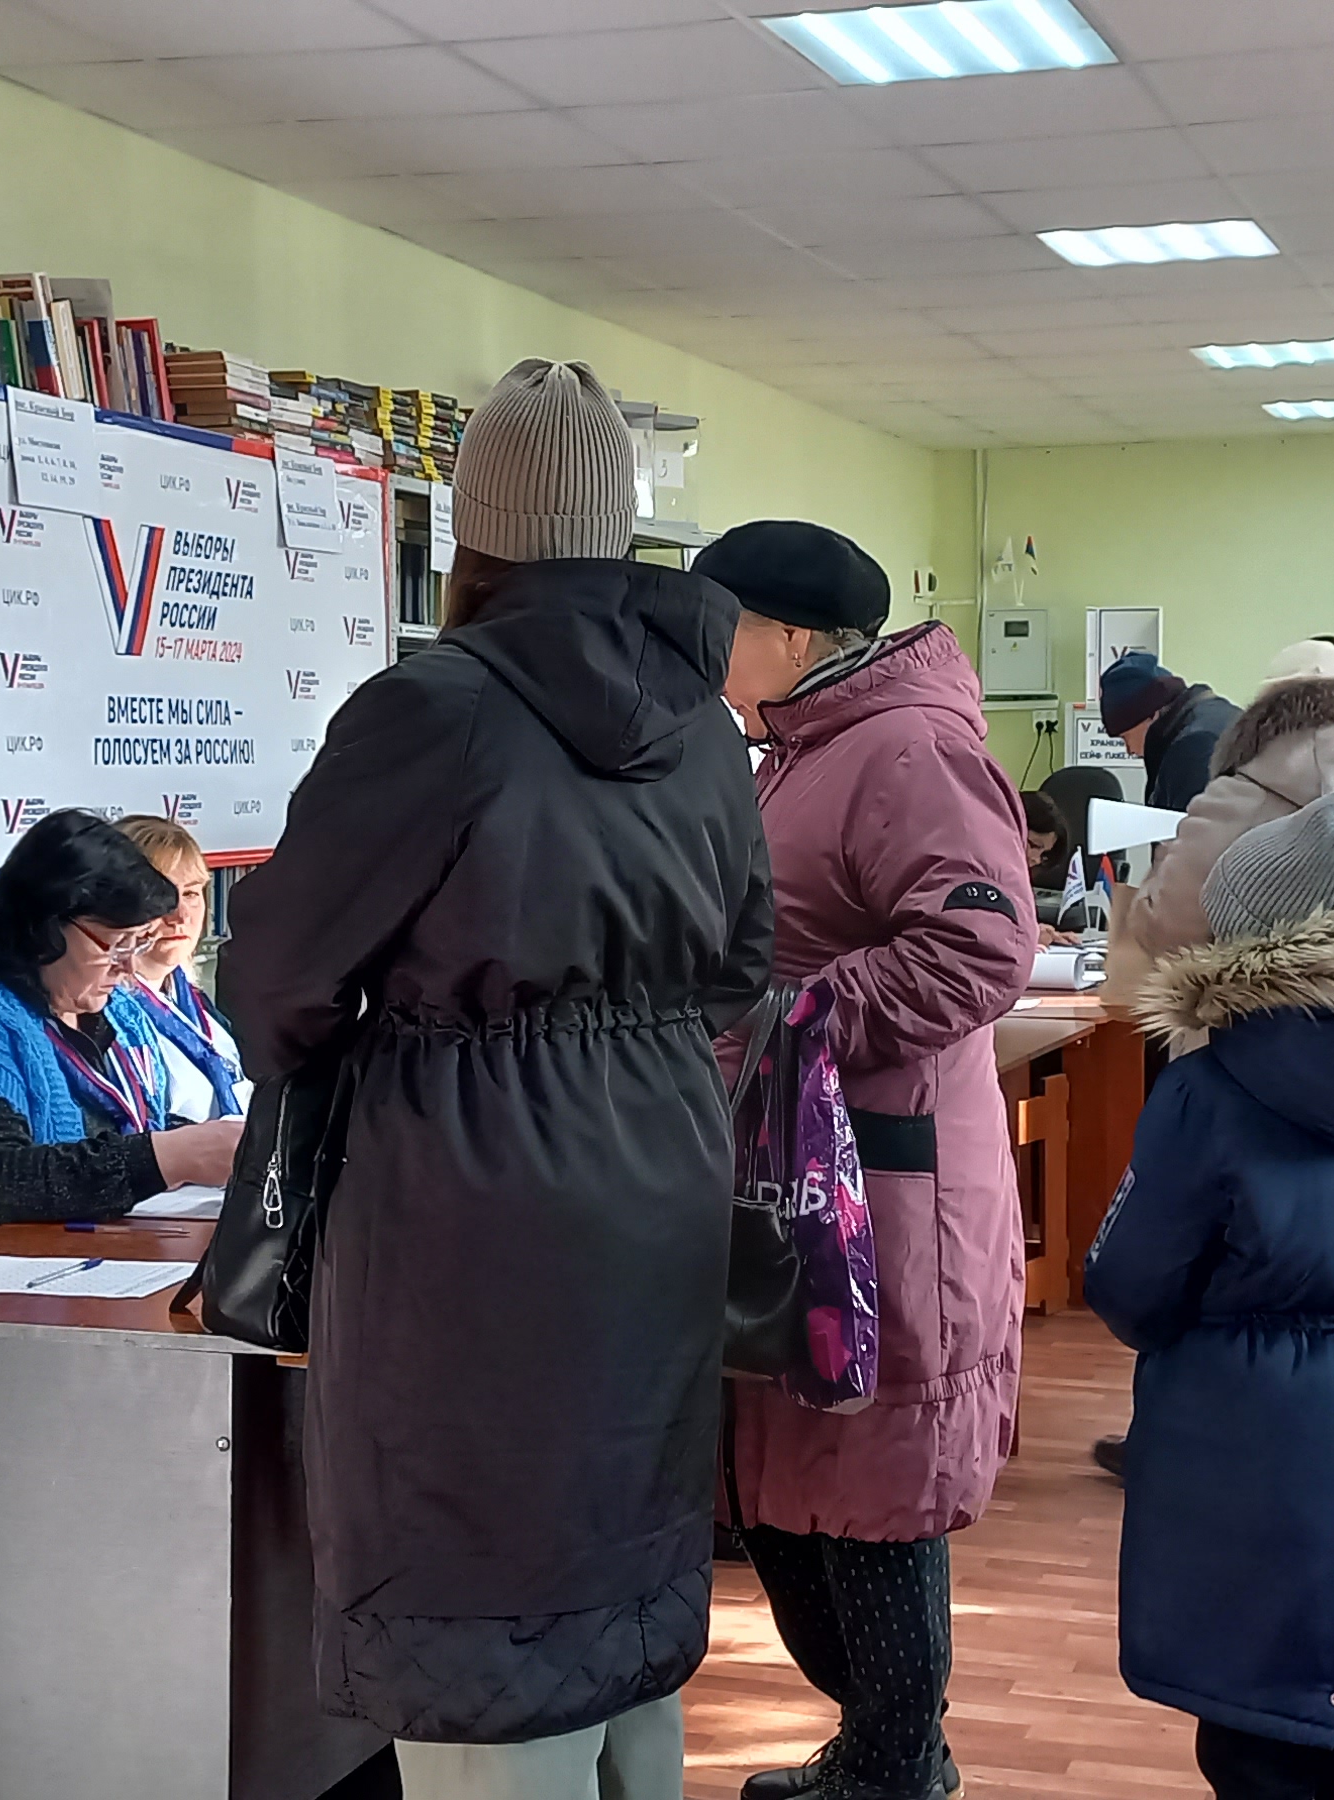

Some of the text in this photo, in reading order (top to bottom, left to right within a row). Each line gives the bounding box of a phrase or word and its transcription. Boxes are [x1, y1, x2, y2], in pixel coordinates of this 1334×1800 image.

[172, 530, 236, 563] ВЫБОРЫ
[165, 565, 255, 601] ПРЕЗИДЕНТА
[159, 601, 218, 632] РОССИИ
[184, 638, 218, 662] МАРТА
[218, 640, 244, 664] 2024
[107, 695, 165, 725] ВМЕСТЕ
[168, 698, 193, 725] МЫ
[196, 699, 232, 726] СИЛА
[93, 737, 256, 766] ГОЛОСУЕМ ЗА РОССИЮ!
